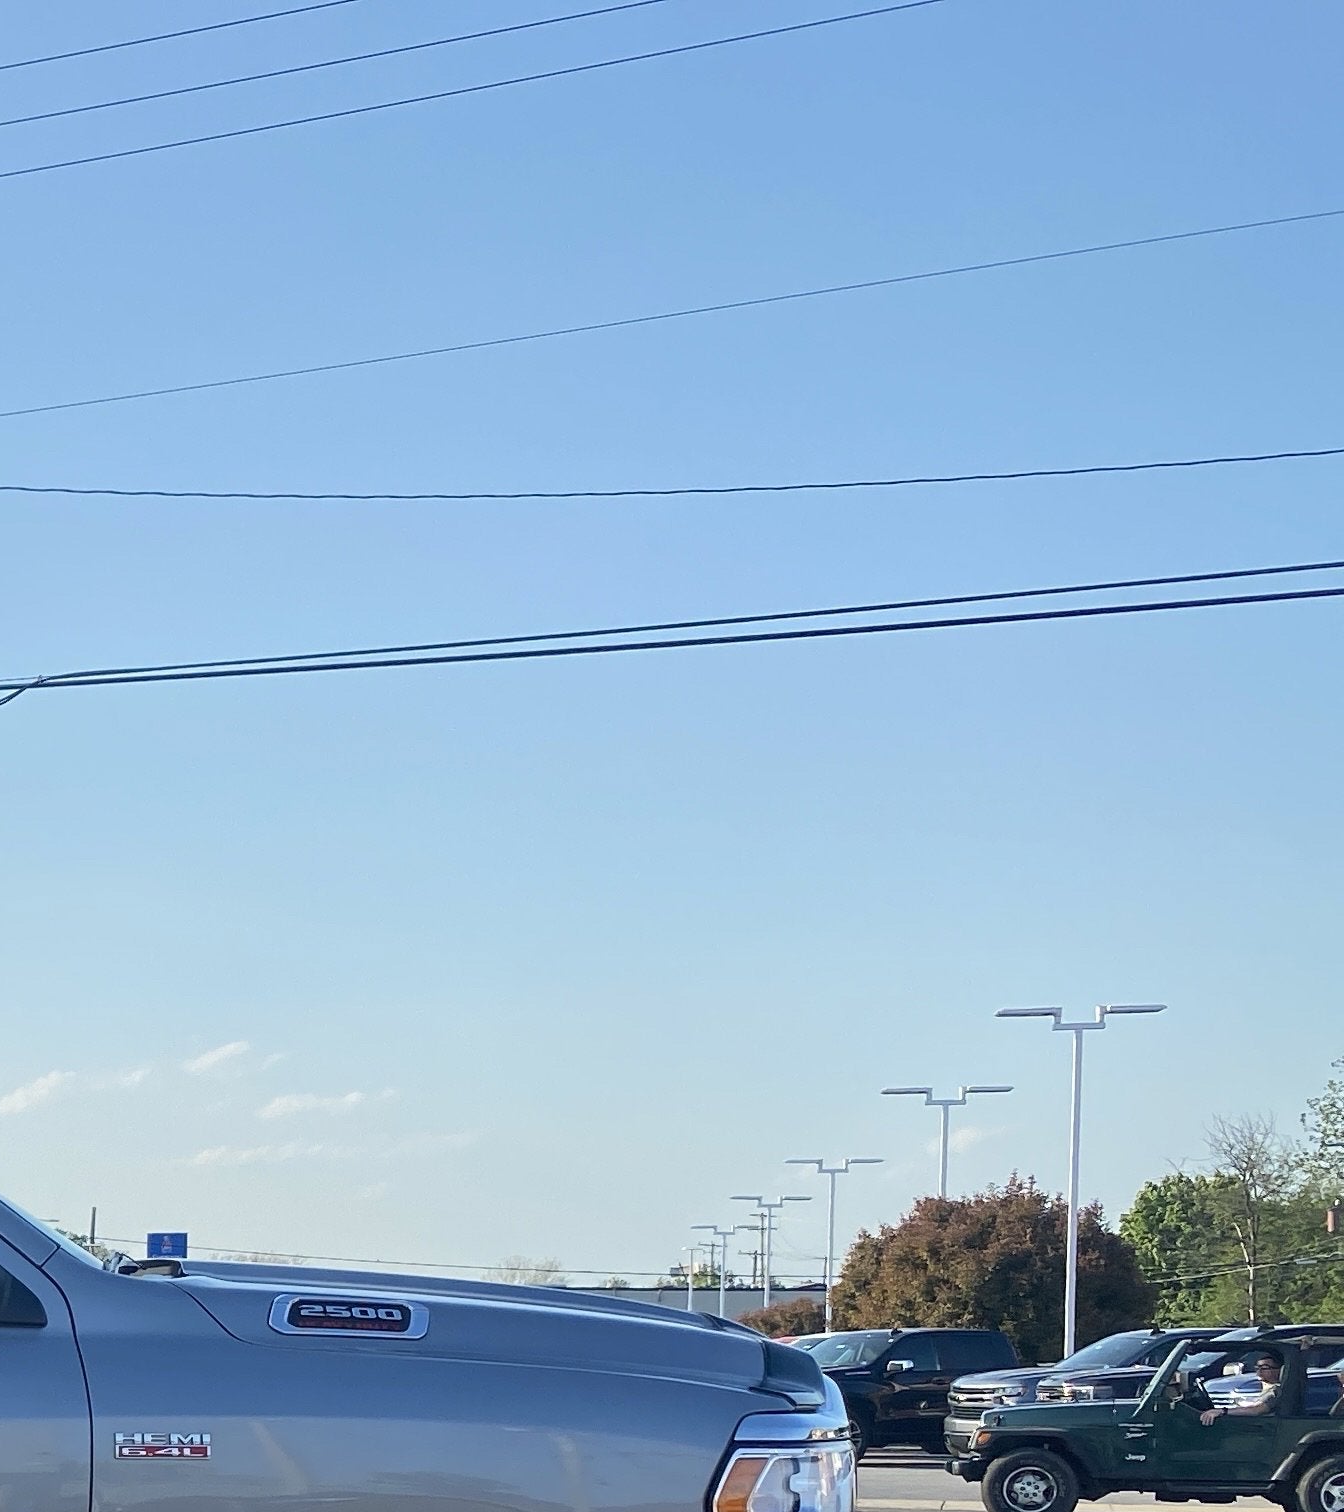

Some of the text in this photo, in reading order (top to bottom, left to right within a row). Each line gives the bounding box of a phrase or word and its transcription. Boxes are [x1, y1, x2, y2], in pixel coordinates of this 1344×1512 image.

[298, 1304, 403, 1321] 2500
[114, 1432, 212, 1446] HEMI
[120, 1446, 207, 1457] 6.4L
